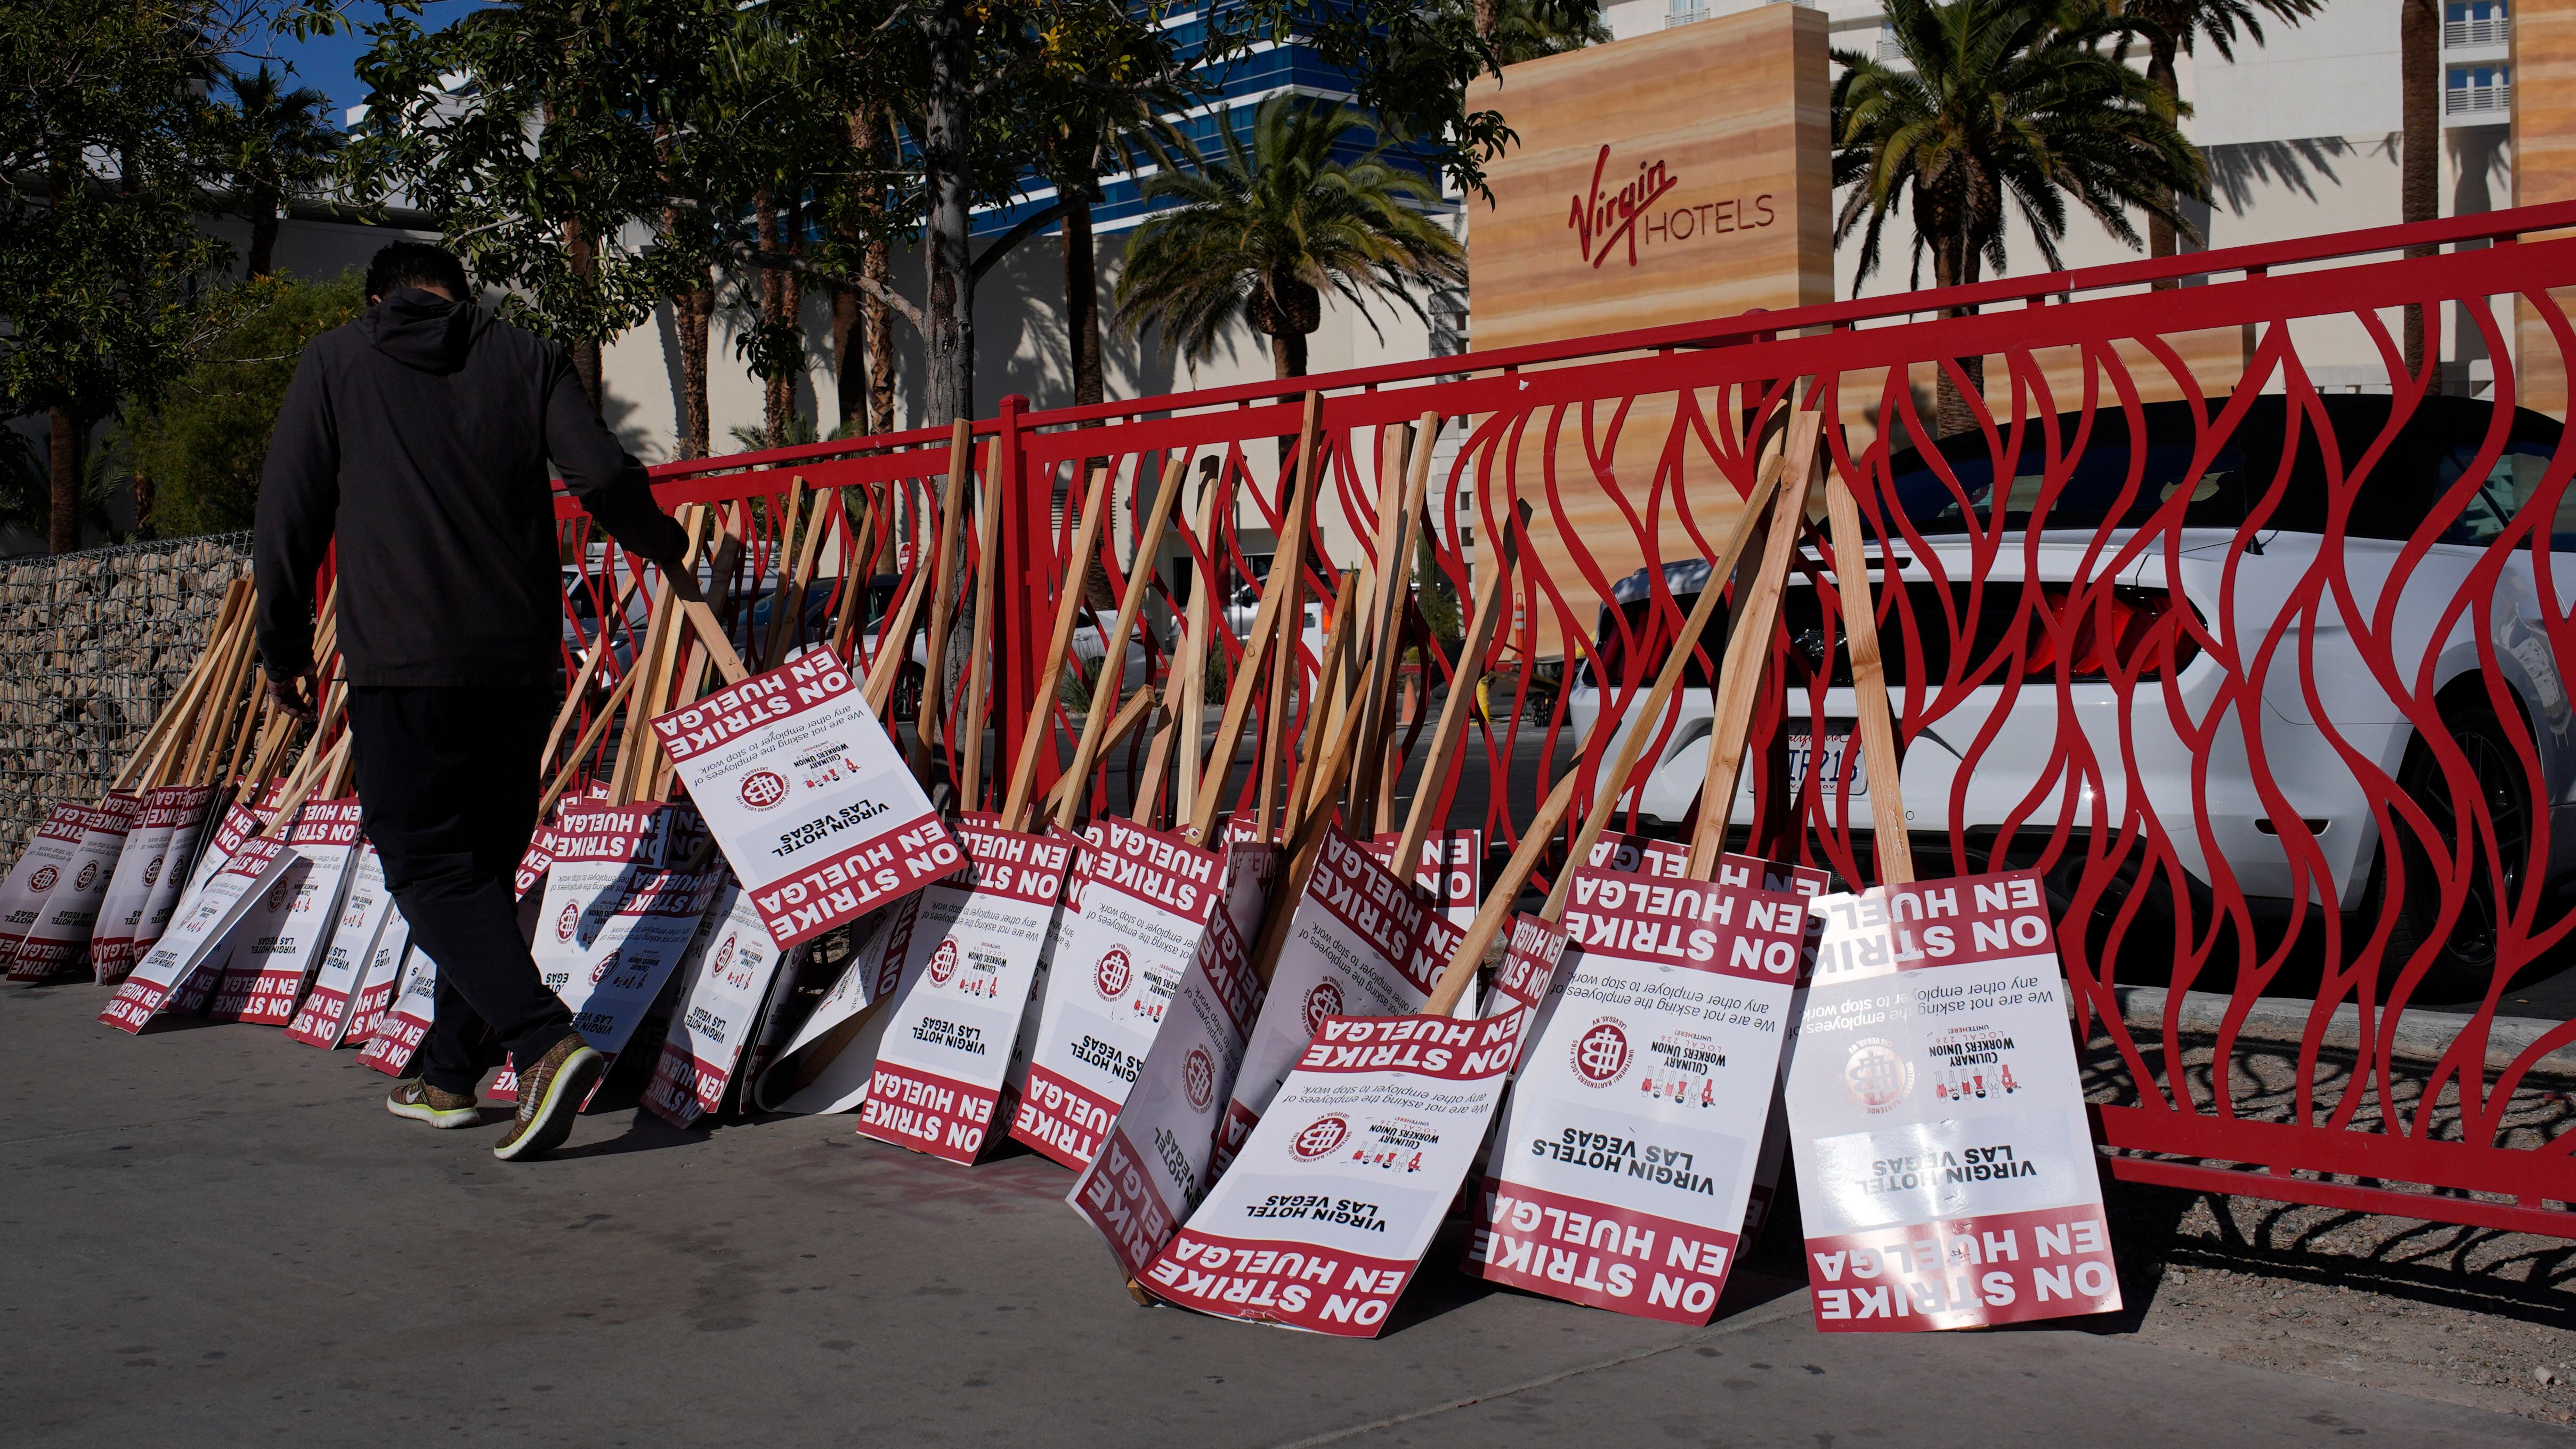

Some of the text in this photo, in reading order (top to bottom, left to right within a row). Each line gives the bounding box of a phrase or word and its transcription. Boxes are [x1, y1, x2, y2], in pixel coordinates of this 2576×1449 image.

[1568, 144, 1775, 269] Virgin HOTELS
[655, 651, 836, 736] EN HUELGA
[666, 672, 847, 758] ON STRIKE
[563, 814, 635, 832] HUELGA
[772, 804, 889, 856] VIRGIN HOTEL
[781, 799, 871, 844] LAS VEGAS
[554, 836, 626, 857] STRIKE
[1030, 843, 1067, 870] EN
[1111, 822, 1213, 884] HUELGA
[1422, 838, 1469, 865] EN
[634, 871, 703, 892] HUELGA
[757, 821, 945, 913] EN HUELGA
[1096, 851, 1197, 911] STRIKE
[1327, 831, 1423, 935] HUELGA
[769, 843, 958, 941] ON STRIKE
[1017, 870, 1058, 899] ON
[615, 892, 688, 912] STRIKE
[1312, 862, 1407, 961] STRIKE
[1576, 876, 1802, 935] EN HUELGA
[1802, 878, 2036, 937] EN HUELG
[4, 915, 33, 925] HOTEL
[52, 917, 71, 926] HOTEL
[1565, 911, 1717, 961] STRIKE
[251, 945, 296, 954] VIRGIN HOTEL
[257, 936, 294, 945] LAS VEGAS
[1729, 936, 1795, 974] ON
[1796, 914, 2047, 980] ON STRIK
[221, 976, 298, 994] EN HUELGA
[372, 988, 391, 1009] EN
[1568, 972, 1769, 1014] any other employer to stop work.
[1799, 974, 2039, 1022] any other employer to stop work.
[266, 998, 292, 1016] ON
[323, 998, 345, 1018] EN
[364, 1010, 385, 1034] ON
[693, 1006, 726, 1031] LAS VEGAS
[1549, 983, 1775, 1033] We are not asking the employees of
[1788, 989, 2053, 1040] We are not asking the employees of
[313, 1018, 336, 1040] ON
[404, 1024, 425, 1046] EN
[685, 1014, 725, 1044] VIRGIN HOTEL
[912, 1027, 985, 1055] VIRGIN HOTEL
[922, 1017, 981, 1041] LAS VEGAS
[1324, 1009, 1523, 1047] EN HUELGA
[1674, 1030, 1712, 1042] UNITEHERE!
[1934, 1030, 2004, 1044] LOCAL 226
[1947, 1024, 1989, 1034] UNITEHERE!
[385, 1047, 411, 1067] ON
[1071, 1043, 1109, 1071] HOTEL
[1083, 1035, 1122, 1063] VEGAS
[1301, 1042, 1513, 1074] ON STRIKE
[1686, 1040, 1722, 1051] LOCAL
[1569, 1040, 1634, 1089] UNITEHERE! BARTENDERS LOCAL #165
[696, 1073, 717, 1099] EN
[873, 1071, 993, 1124] EN HUELGA
[862, 1098, 983, 1152] ON STRIKE
[1562, 1128, 1693, 1171] LAS VEGAS
[1872, 1145, 2012, 1176] LAS VEGAS
[1532, 1139, 1714, 1195] VIRGIN HOTELS
[1854, 1160, 2037, 1194] VIRGIN HOTEL
[1245, 1205, 1386, 1232] VIRGIN HOTEL
[1265, 1195, 1379, 1217] LAS VEGAS
[1486, 1193, 1728, 1276] EN HUELGA
[1814, 1219, 2101, 1281] EN HUELGA
[1176, 1237, 1405, 1294] EN HUELGA
[1469, 1230, 1715, 1313] ON STRIKE
[1147, 1258, 1388, 1325] ON STRIKE
[1817, 1260, 2112, 1320] ON STRIKE
